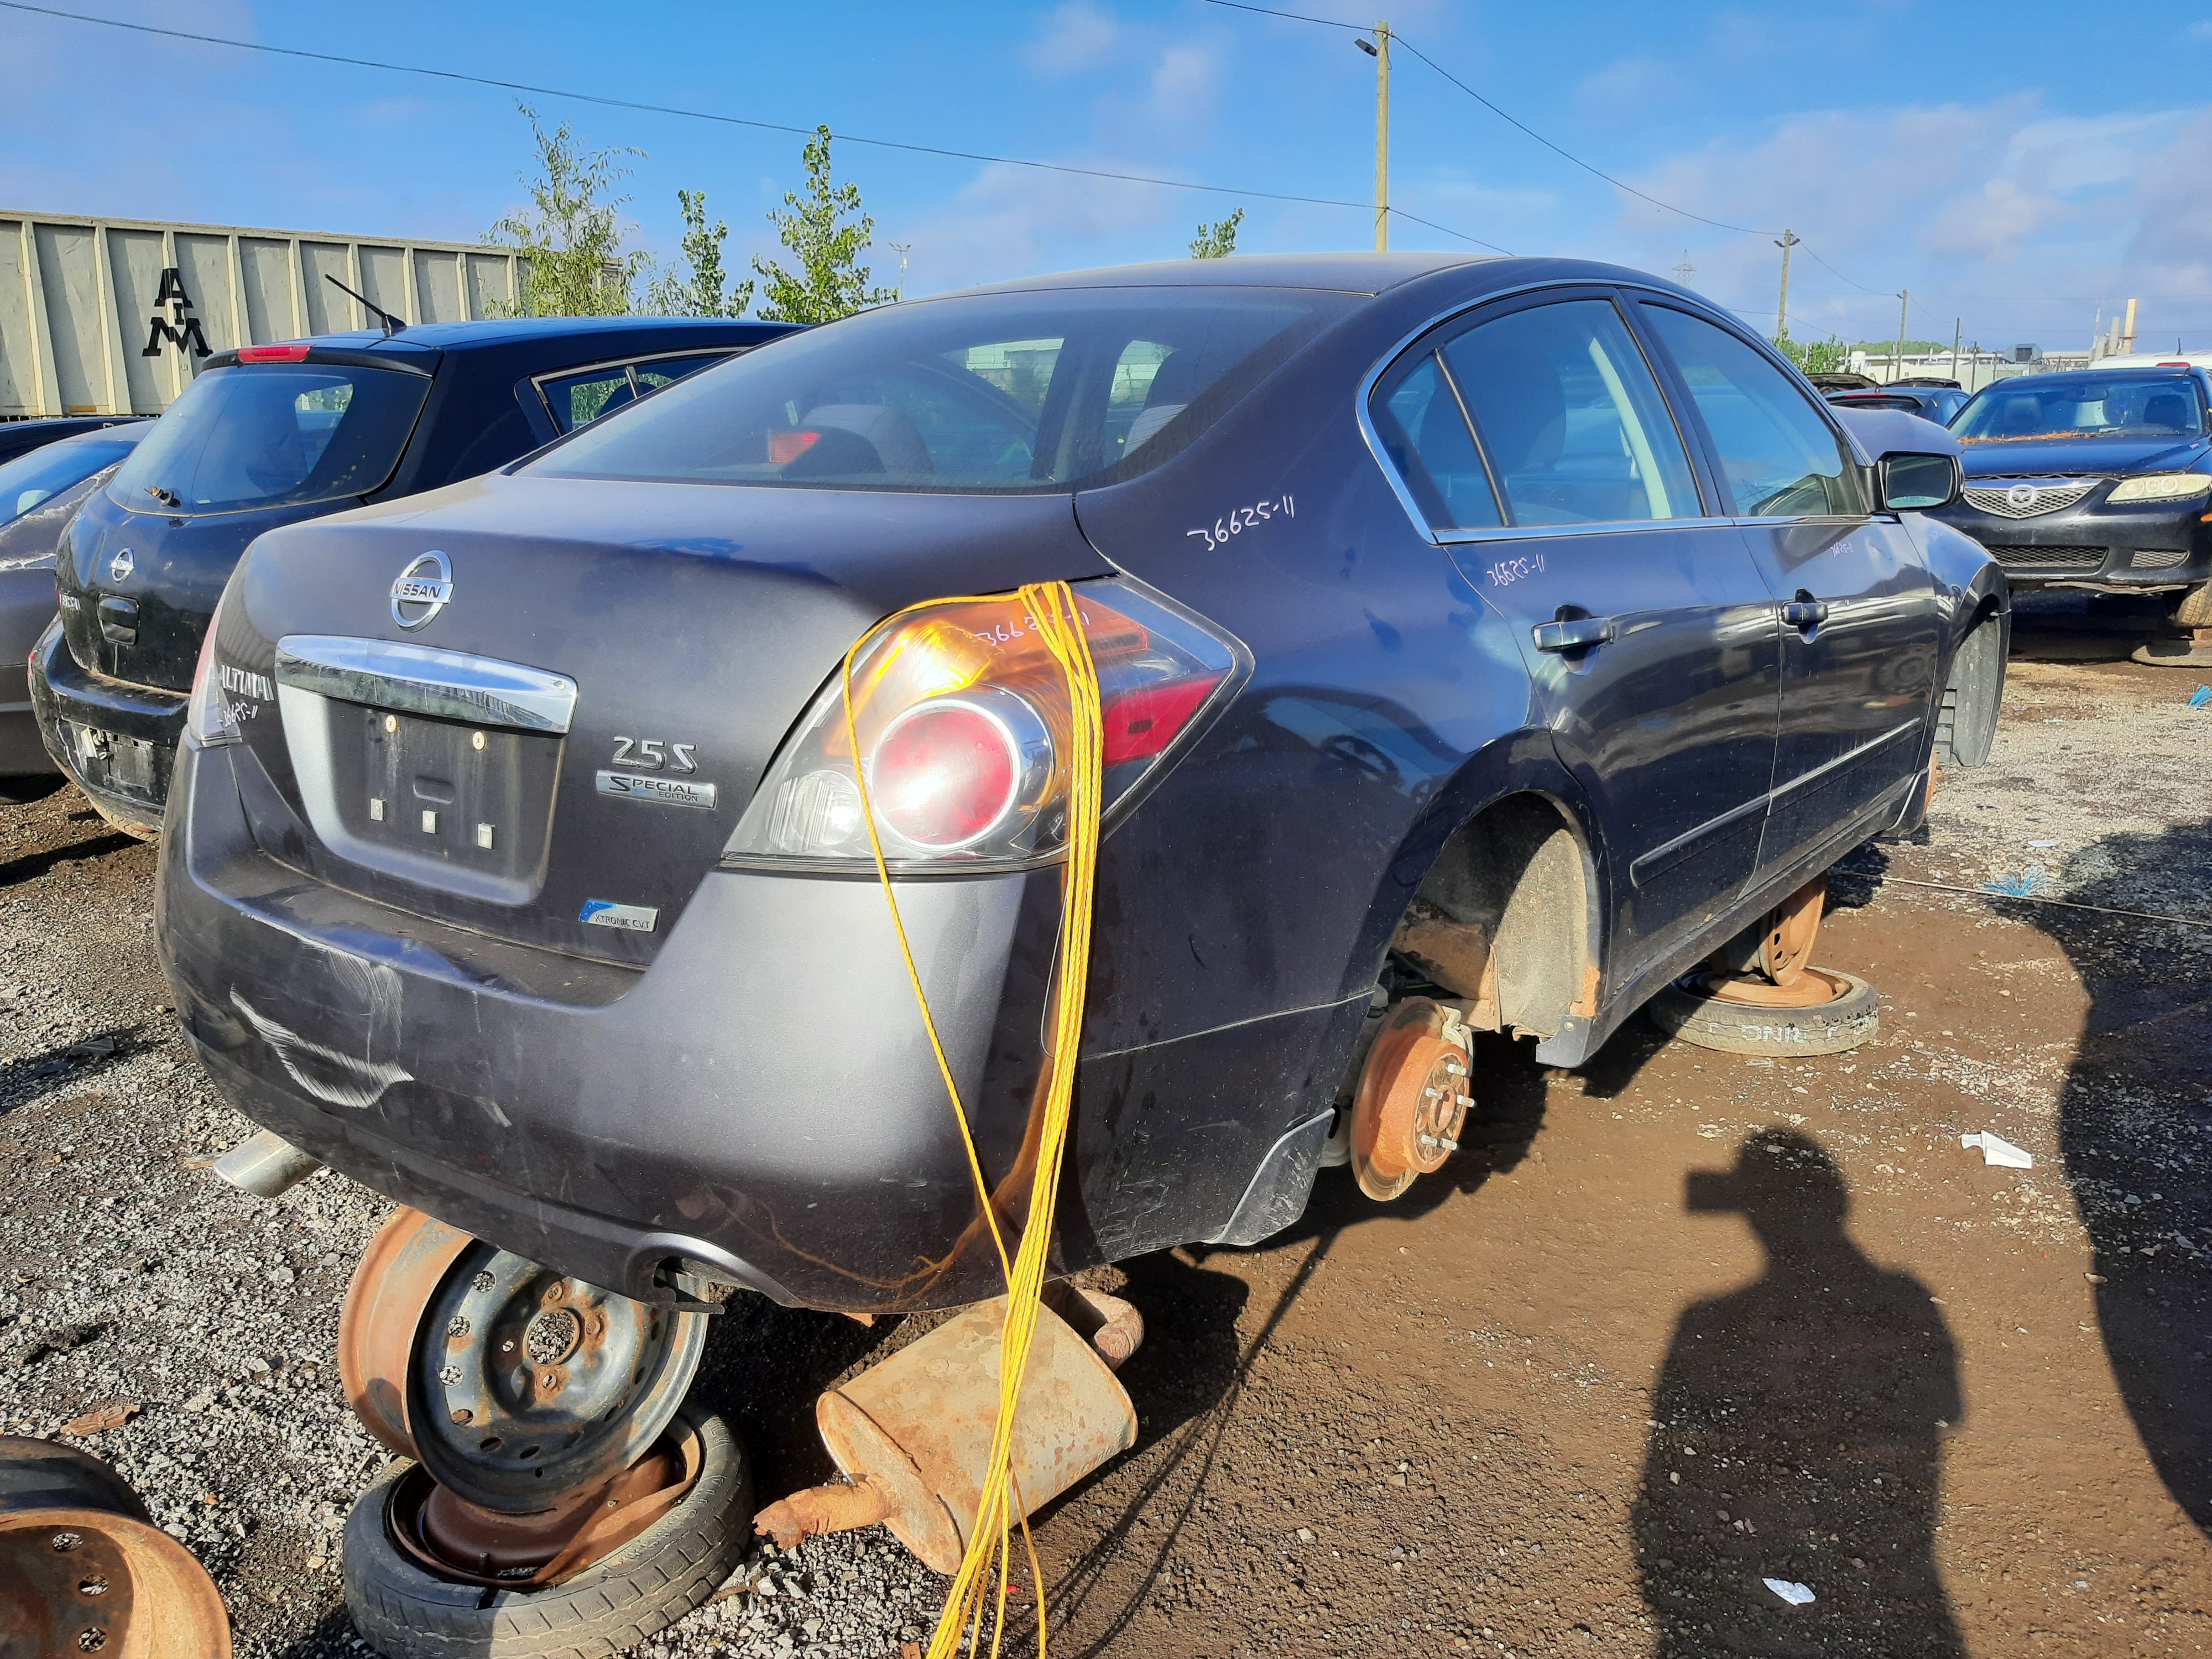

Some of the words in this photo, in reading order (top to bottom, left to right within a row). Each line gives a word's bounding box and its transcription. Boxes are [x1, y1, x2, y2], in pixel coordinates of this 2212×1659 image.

[1186, 495, 1295, 551] 36625-11
[1486, 554, 1545, 587] 36625-11
[393, 582, 441, 598] NISSAN
[223, 701, 259, 727] 36625-11
[609, 775, 698, 795] SPECIAL
[659, 791, 698, 802] EDITION
[594, 914, 631, 927] XTRONIC
[633, 920, 650, 928] CVT
